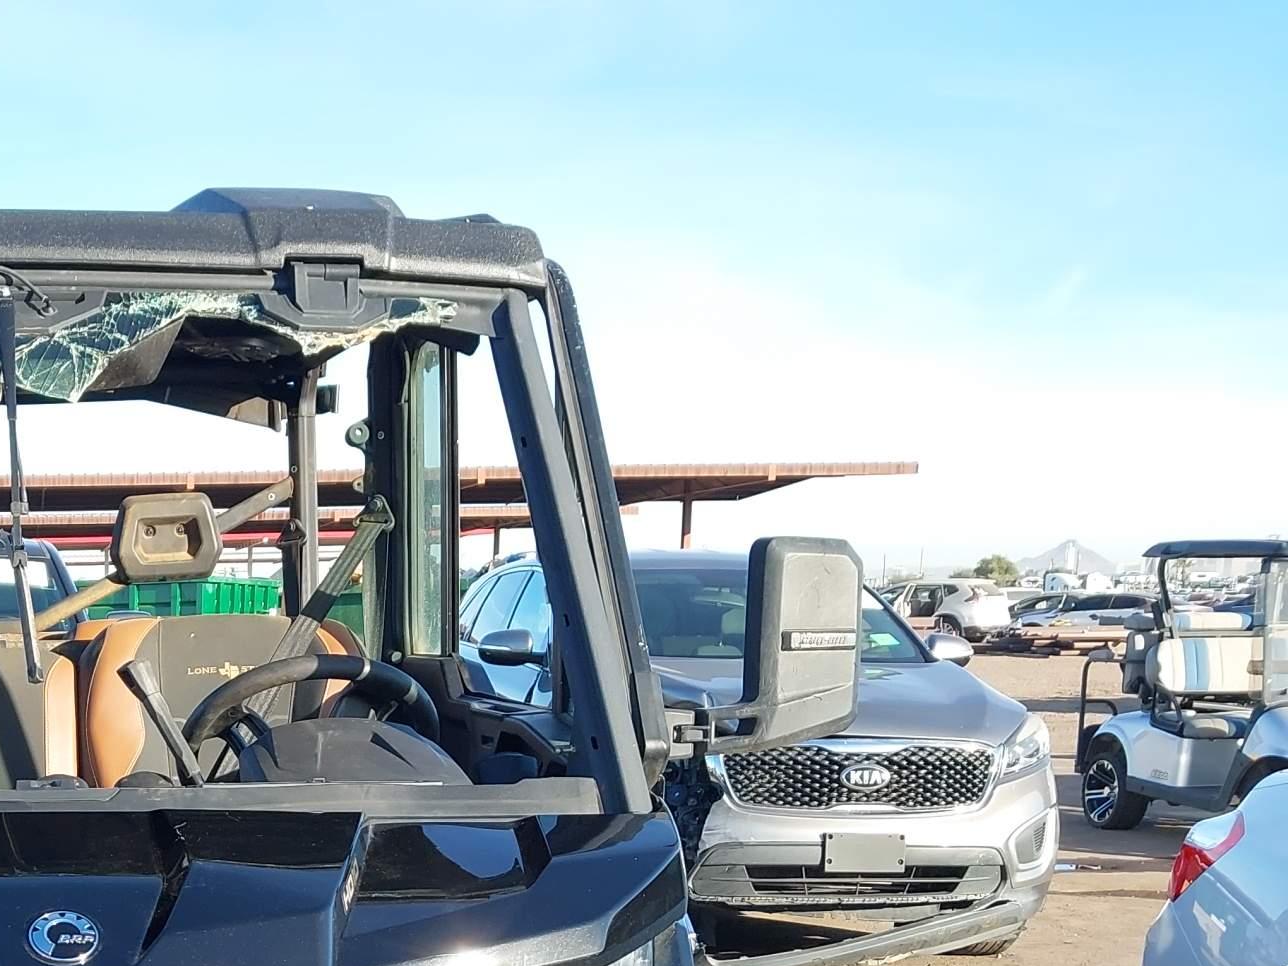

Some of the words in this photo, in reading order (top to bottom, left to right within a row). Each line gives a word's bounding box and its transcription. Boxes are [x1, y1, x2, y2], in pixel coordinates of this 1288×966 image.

[187, 666, 217, 675] LONE
[850, 770, 882, 785] KIA
[57, 934, 95, 944] BRP
